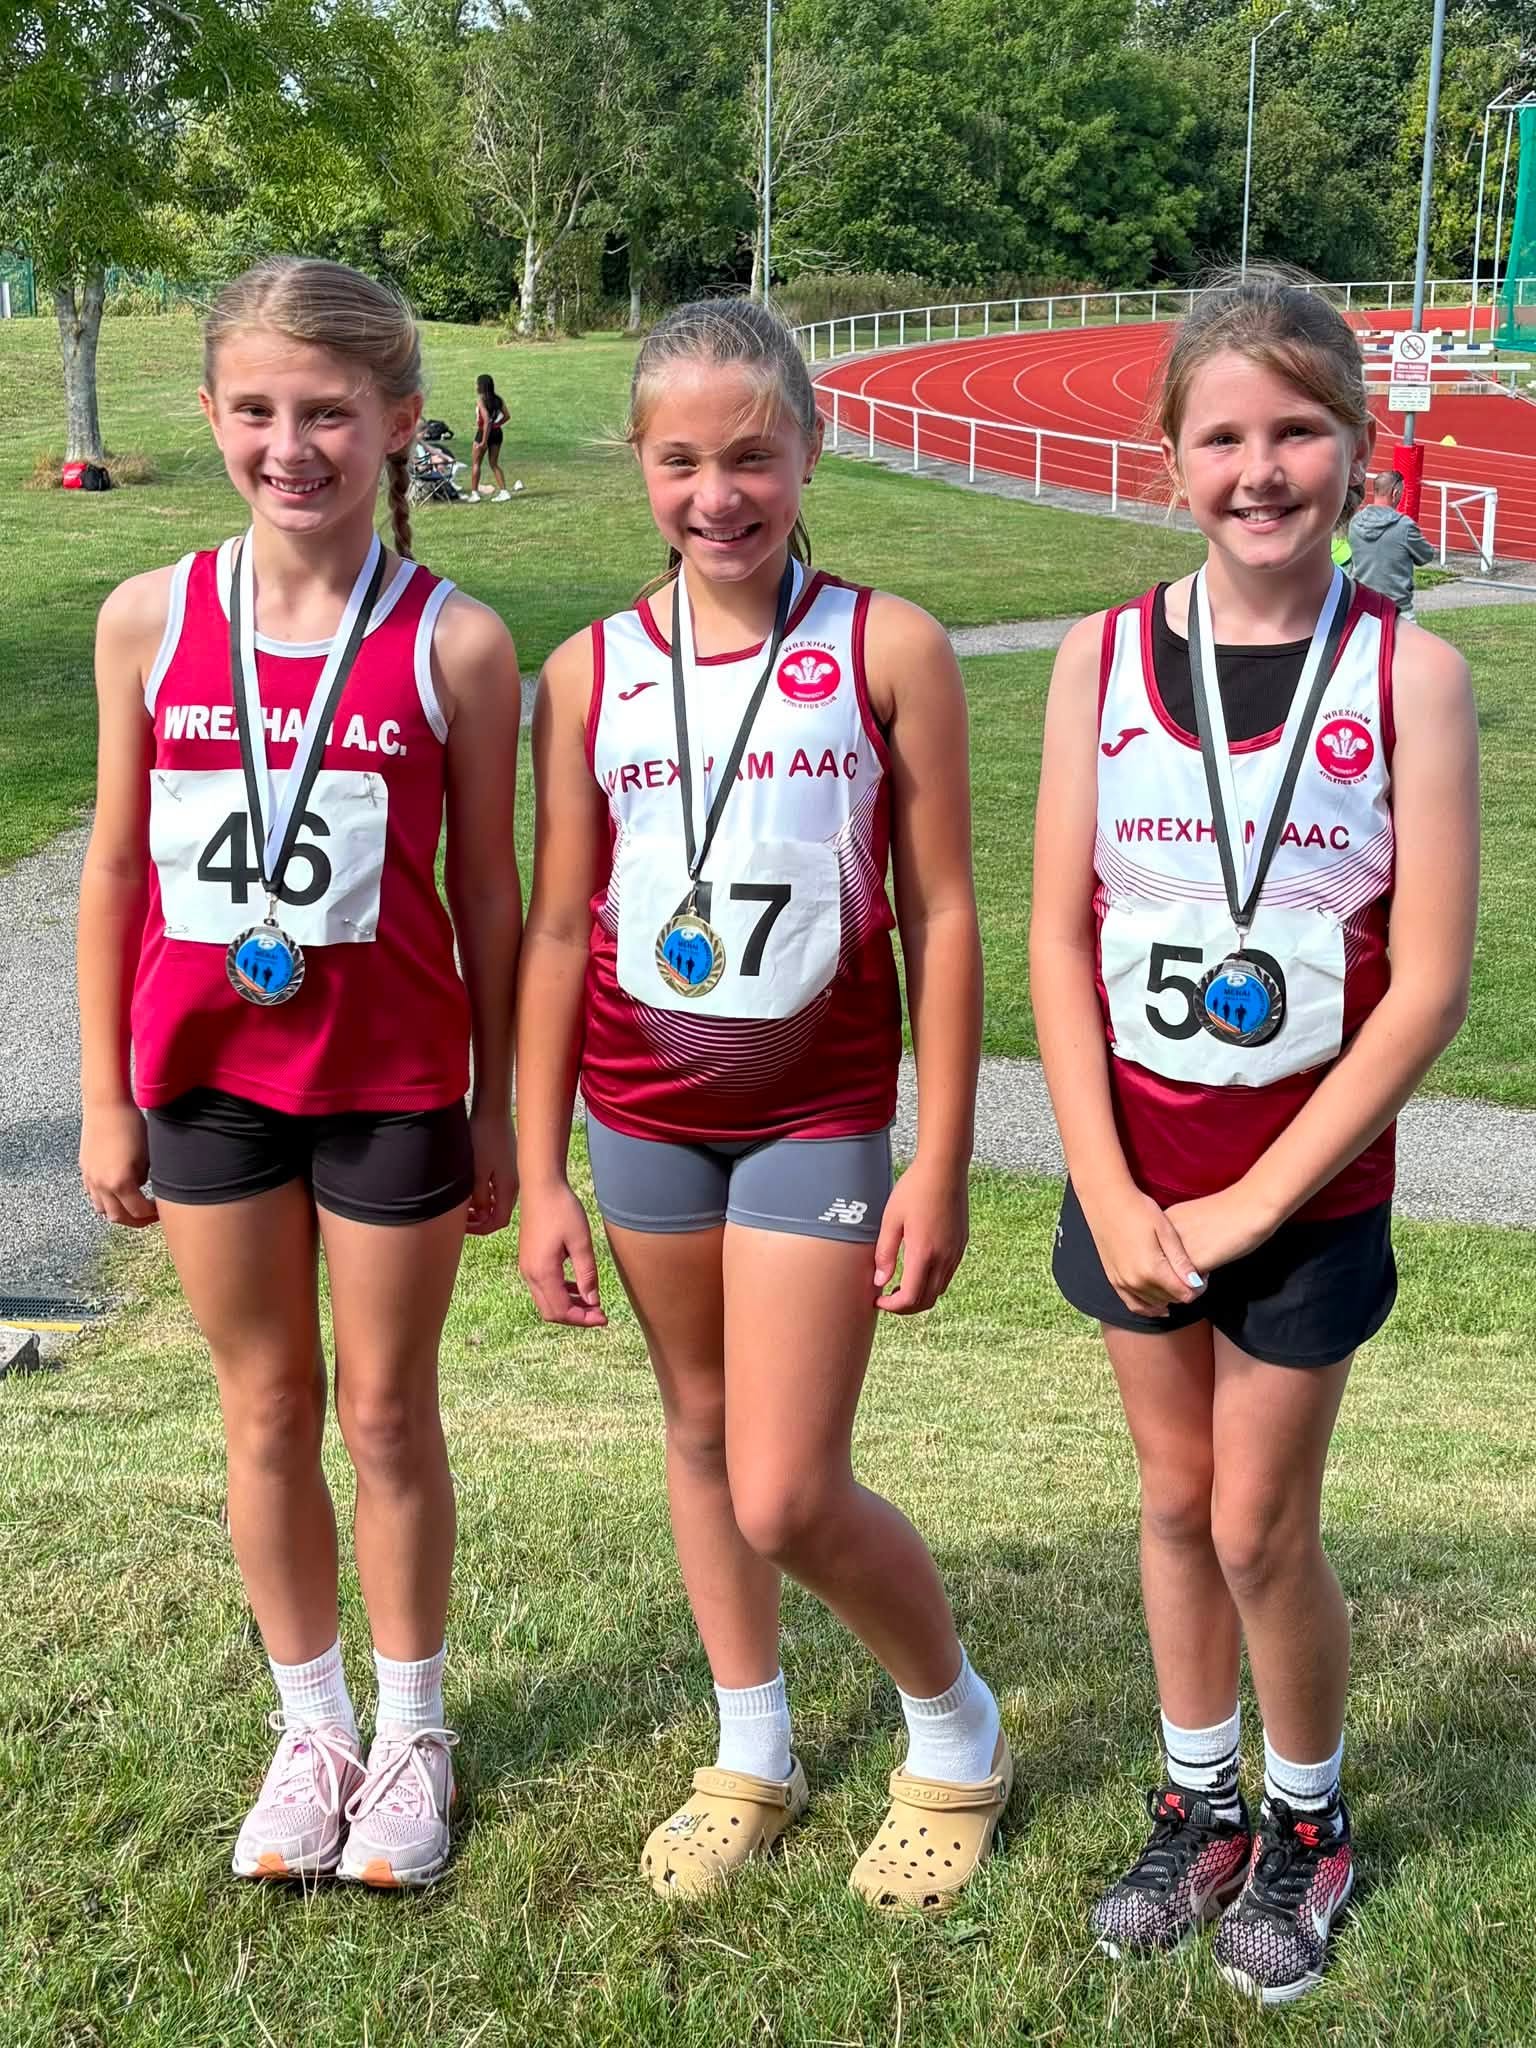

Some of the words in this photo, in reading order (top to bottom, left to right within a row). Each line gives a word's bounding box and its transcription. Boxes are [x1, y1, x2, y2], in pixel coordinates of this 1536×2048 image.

[783, 640, 836, 653] WREXHAM
[162, 704, 334, 746] WREHA
[342, 714, 408, 757] A.C.
[1322, 708, 1372, 725] WREXHAM
[601, 750, 774, 798] WREXM
[788, 748, 858, 781] AAC
[1115, 817, 1257, 845] WREXH
[1280, 822, 1350, 850] AAC
[197, 811, 333, 906] 46
[1293, 1821, 1320, 1837] NIKE
